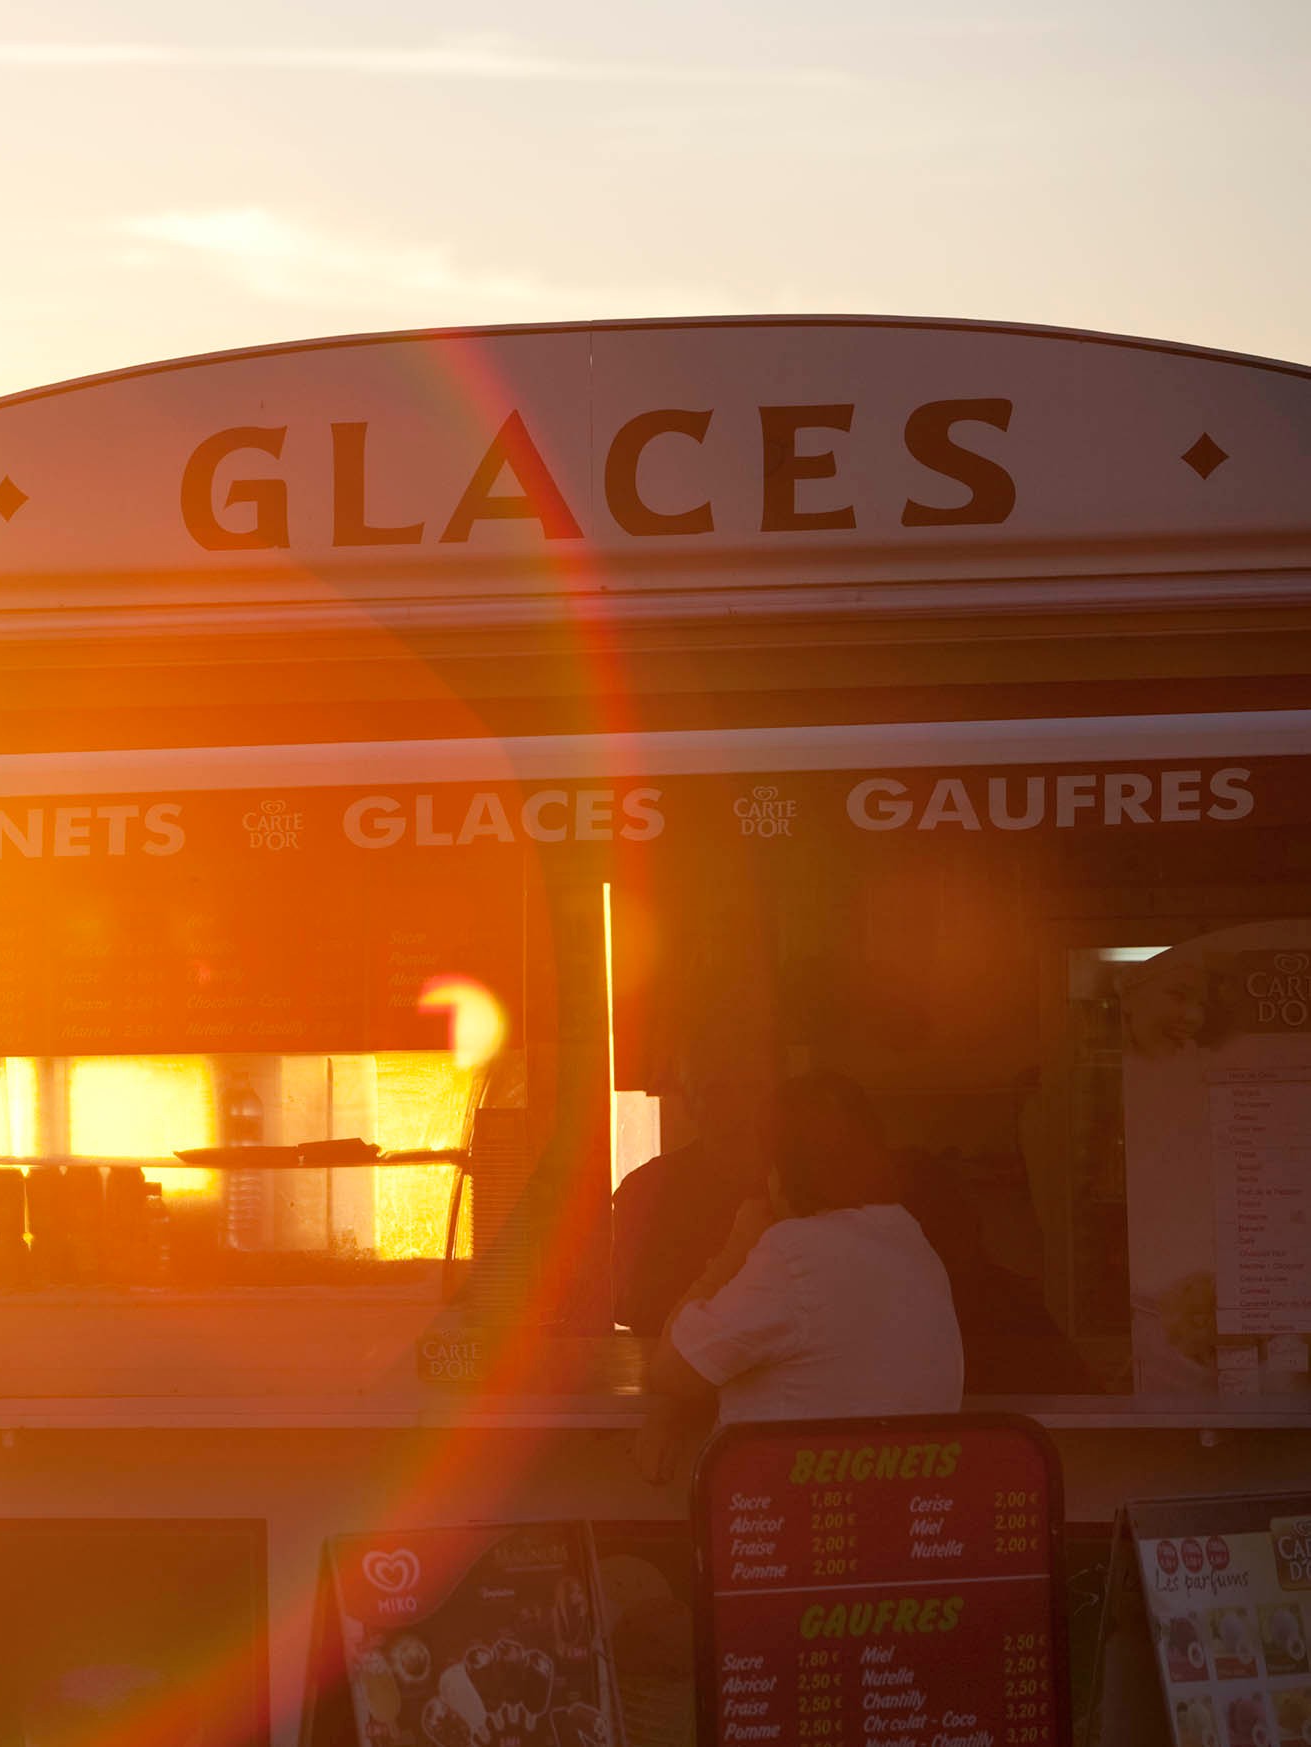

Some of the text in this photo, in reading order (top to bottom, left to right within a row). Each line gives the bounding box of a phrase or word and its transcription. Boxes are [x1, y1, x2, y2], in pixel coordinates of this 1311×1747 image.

[181, 397, 1016, 551] GLACES
[733, 796, 797, 820] CARTE
[846, 767, 1255, 832] GAUFRES
[241, 809, 303, 833] CARTE
[343, 788, 665, 850] GLACES
[741, 815, 793, 839] D'OR
[250, 829, 301, 852] D'OR
[423, 1341, 482, 1362] CARTE
[430, 1359, 477, 1378] D'OR
[788, 1441, 962, 1485] BEIGNETS
[729, 1493, 772, 1511] Sucre
[909, 1493, 953, 1513] Cerise
[995, 1491, 1026, 1510] 2,00
[729, 1516, 785, 1534] Abricot
[909, 1517, 945, 1536] Miel
[730, 1538, 776, 1557] Fraise
[910, 1539, 964, 1559] Nutella
[995, 1537, 1026, 1554] 2,00
[731, 1562, 789, 1580] Pomme
[1184, 1567, 1249, 1598] parfums
[378, 1596, 417, 1614] MIKO
[800, 1596, 964, 1640] GAUFRES
[722, 1652, 764, 1672] Sucre
[860, 1644, 896, 1665] Miel
[862, 1667, 915, 1687] Nutella
[1005, 1656, 1036, 1675] 2,50
[722, 1673, 778, 1694] Abricot
[724, 1697, 769, 1717] Fraise
[862, 1688, 927, 1711] Chantilly
[942, 1710, 977, 1728] Coco
[724, 1722, 781, 1742] Pomme
